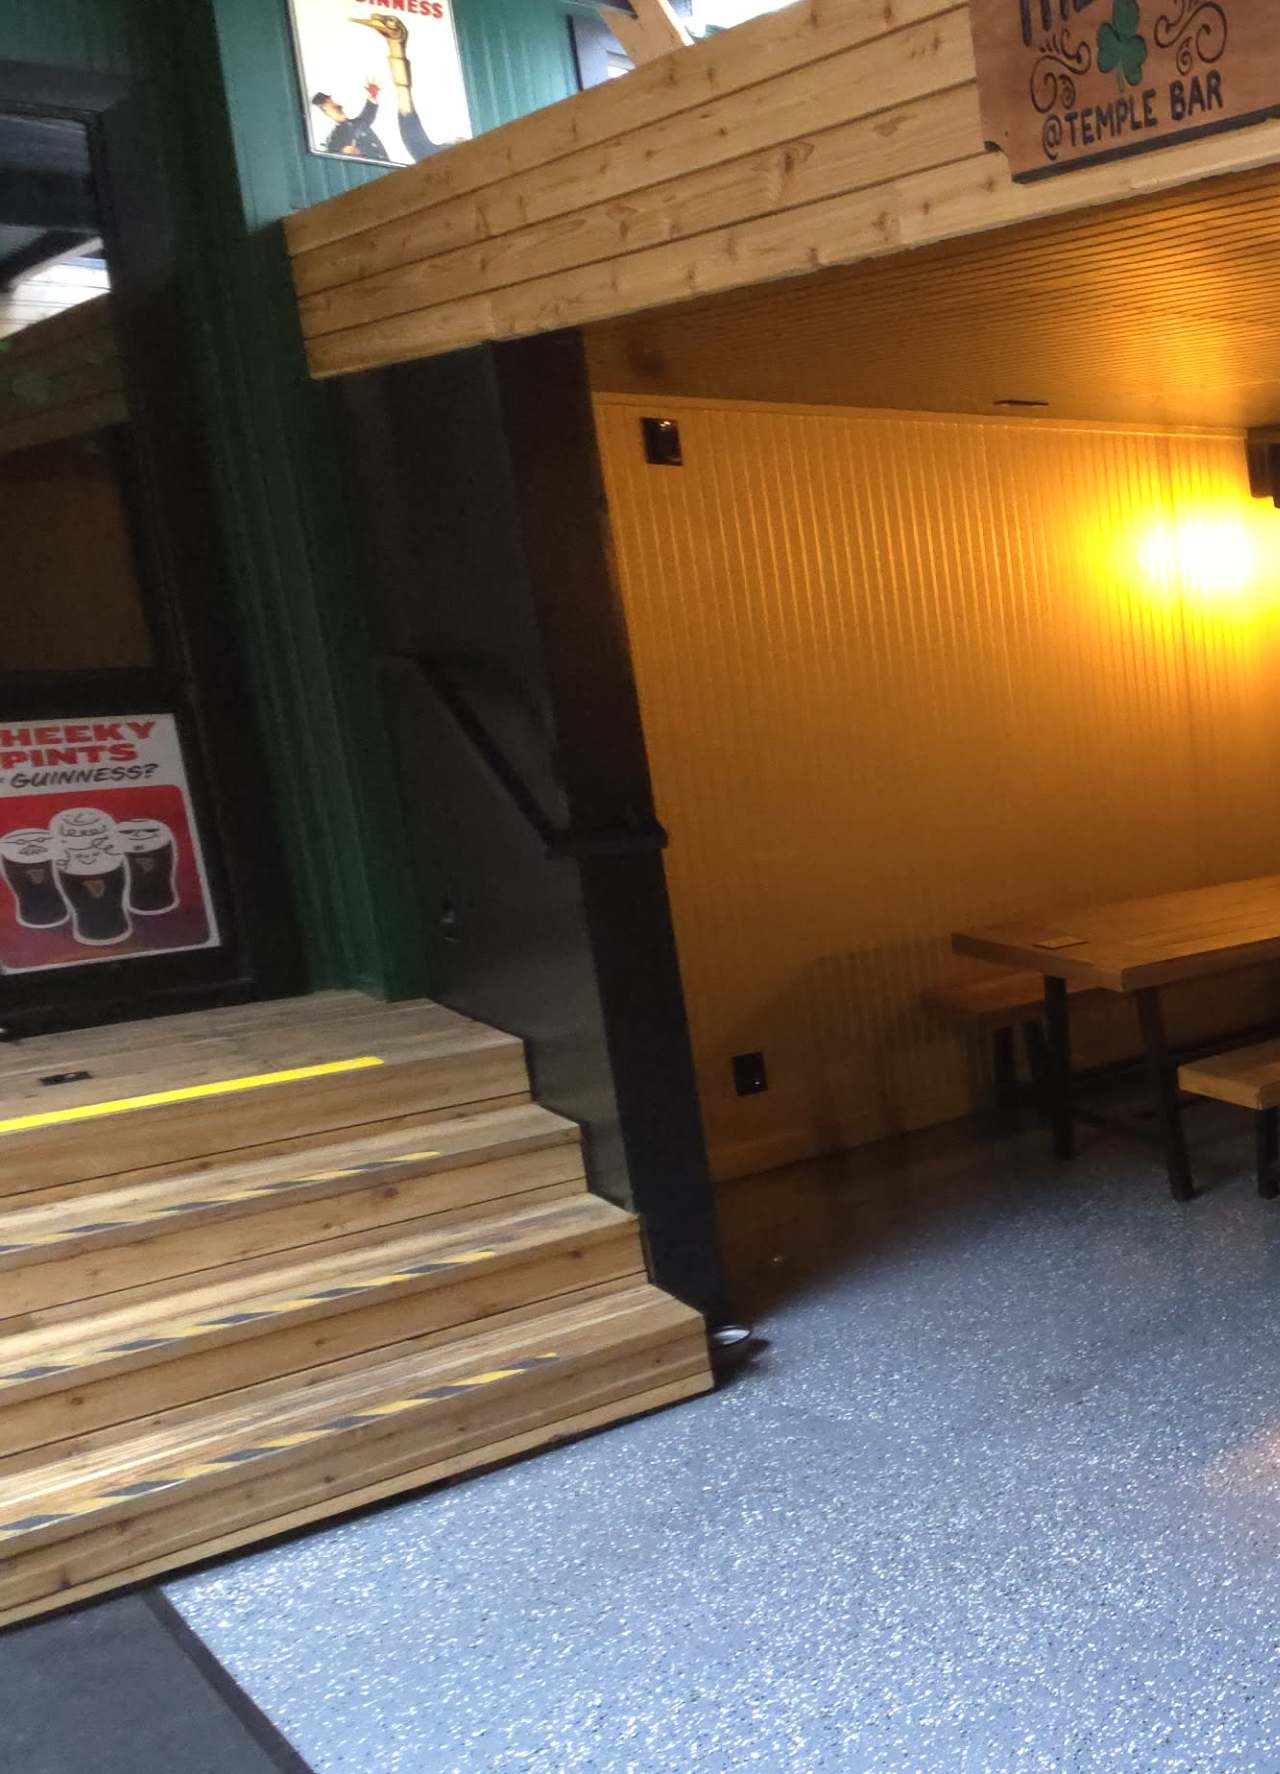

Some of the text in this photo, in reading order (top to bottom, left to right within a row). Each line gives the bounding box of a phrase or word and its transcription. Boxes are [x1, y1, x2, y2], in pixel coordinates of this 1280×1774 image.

[1042, 70, 1224, 161] @TEMPLE BAR
[0, 721, 156, 747] HEEKY
[0, 743, 138, 769] PINTS
[10, 763, 159, 788] GUINNESS?
